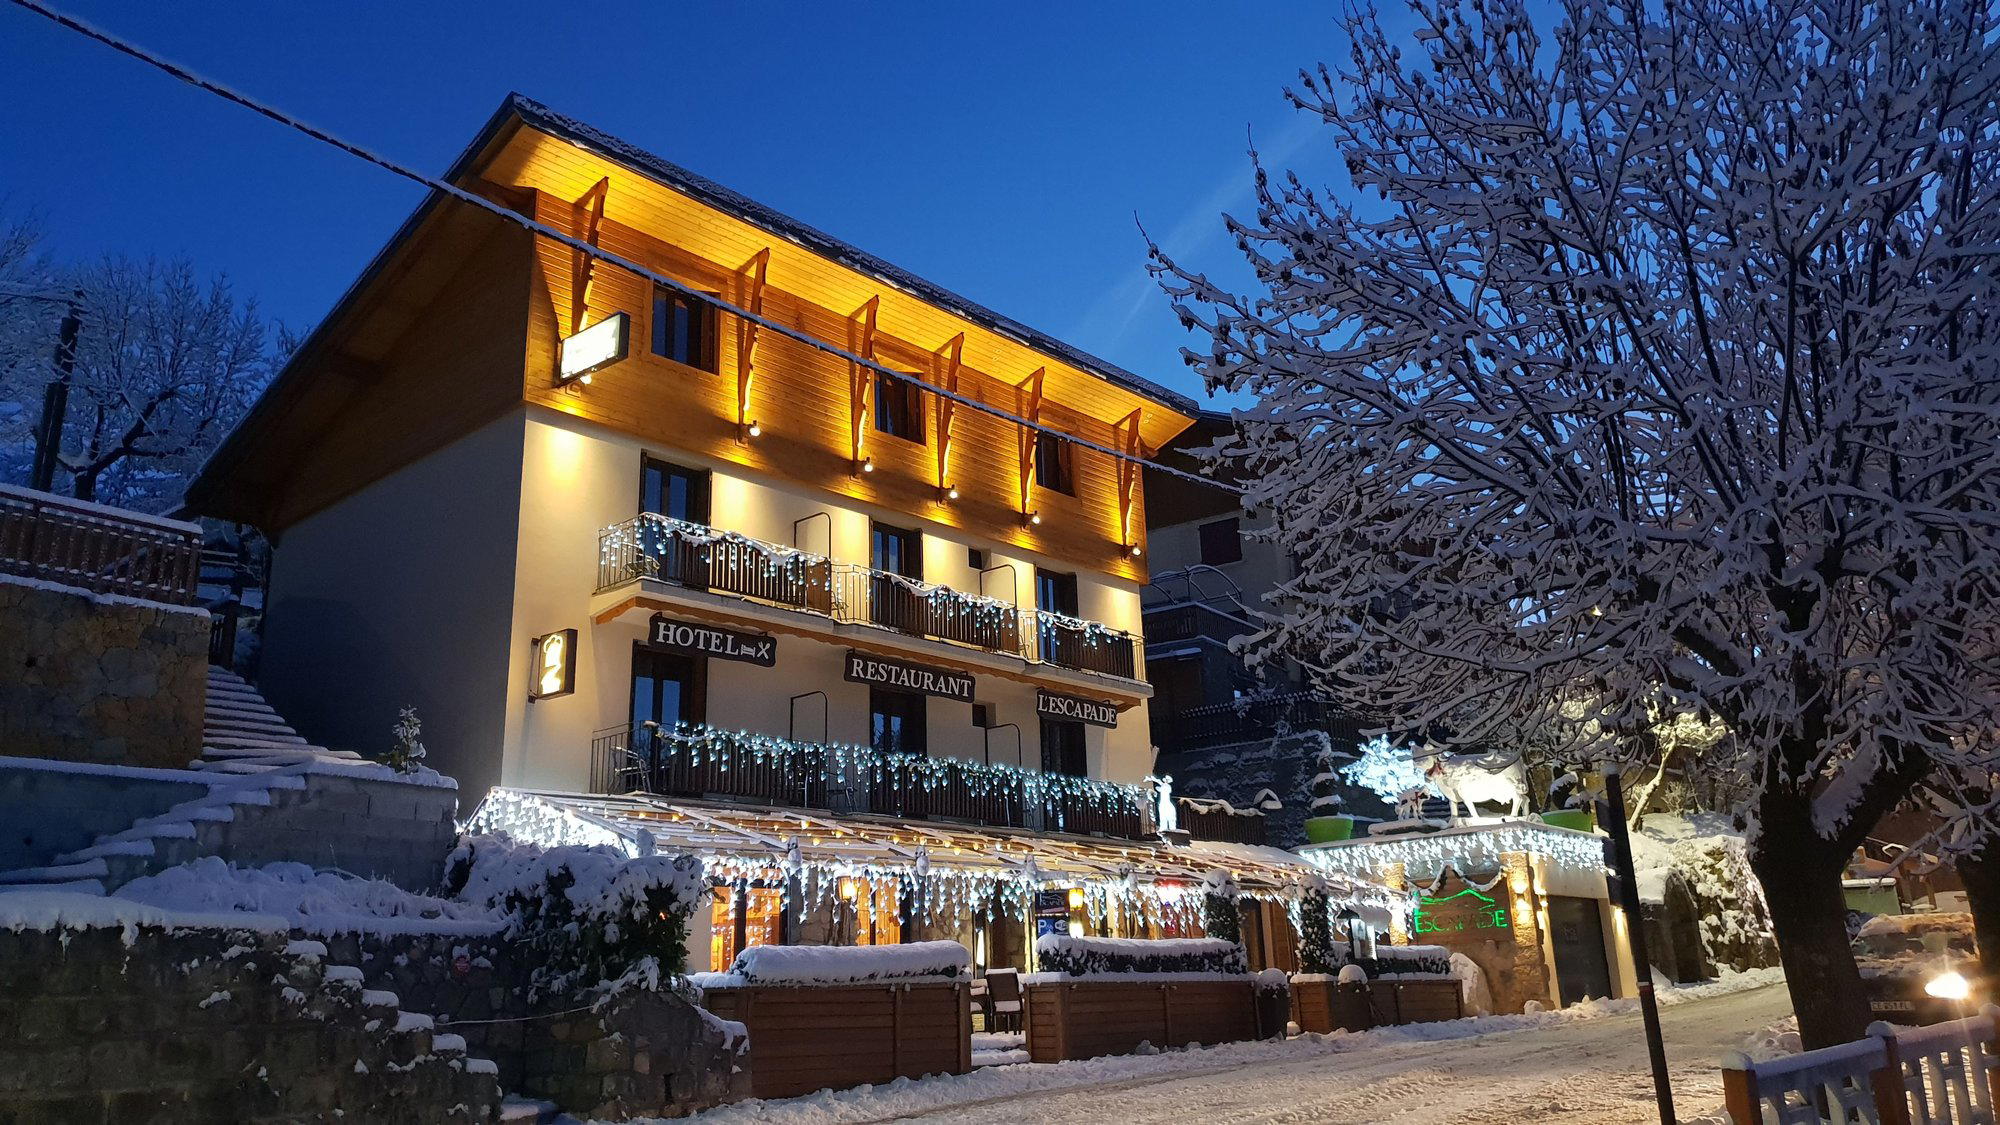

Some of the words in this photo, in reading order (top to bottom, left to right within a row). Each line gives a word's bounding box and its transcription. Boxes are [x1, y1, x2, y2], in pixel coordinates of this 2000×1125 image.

[656, 621, 739, 656] HOTEL
[850, 657, 972, 698] RESTAURANT
[1037, 693, 1117, 725] L'ESCAPADE
